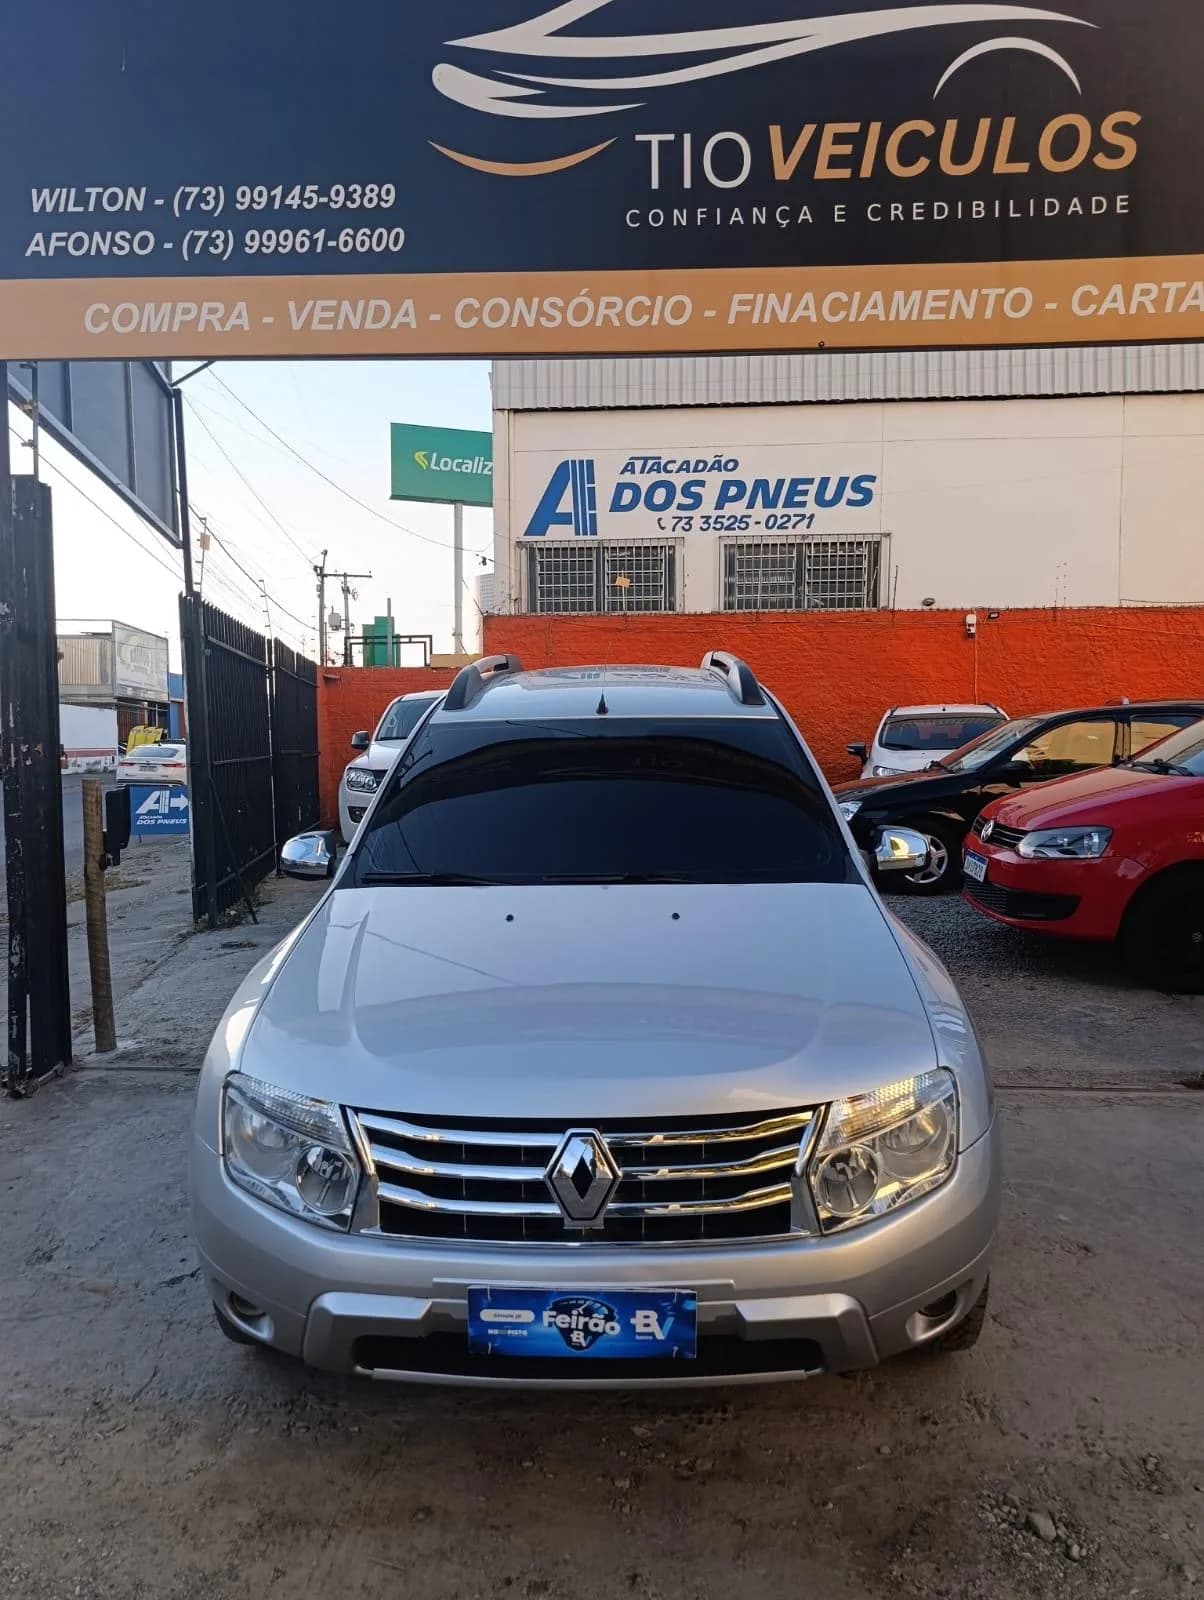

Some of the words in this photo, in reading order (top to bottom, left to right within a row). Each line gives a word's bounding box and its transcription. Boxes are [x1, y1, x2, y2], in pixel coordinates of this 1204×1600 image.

[635, 131, 752, 190] TIO
[768, 110, 1142, 182] VEICULOS
[31, 186, 147, 213] WILTON
[173, 185, 225, 218] (73)
[235, 184, 396, 210] 99145-9389
[625, 205, 814, 229] CONFIANÇA
[834, 204, 847, 223] E
[867, 194, 1130, 222] CREDIBILIDADE
[25, 231, 156, 257] AFONSO
[182, 229, 234, 261] (73)
[244, 228, 405, 254] 99961-6600
[84, 302, 250, 334] COMPRA
[288, 299, 417, 331] VENDA
[454, 288, 693, 329] CONSÓRCIO
[728, 287, 1033, 325] FINACIAMENTO
[430, 452, 493, 475] Localiz
[620, 455, 739, 475] ATACADÃO
[609, 480, 706, 512] DOS
[714, 475, 877, 510] PNEUS
[671, 517, 694, 532] 73
[542, 1309, 621, 1336] Feirão
